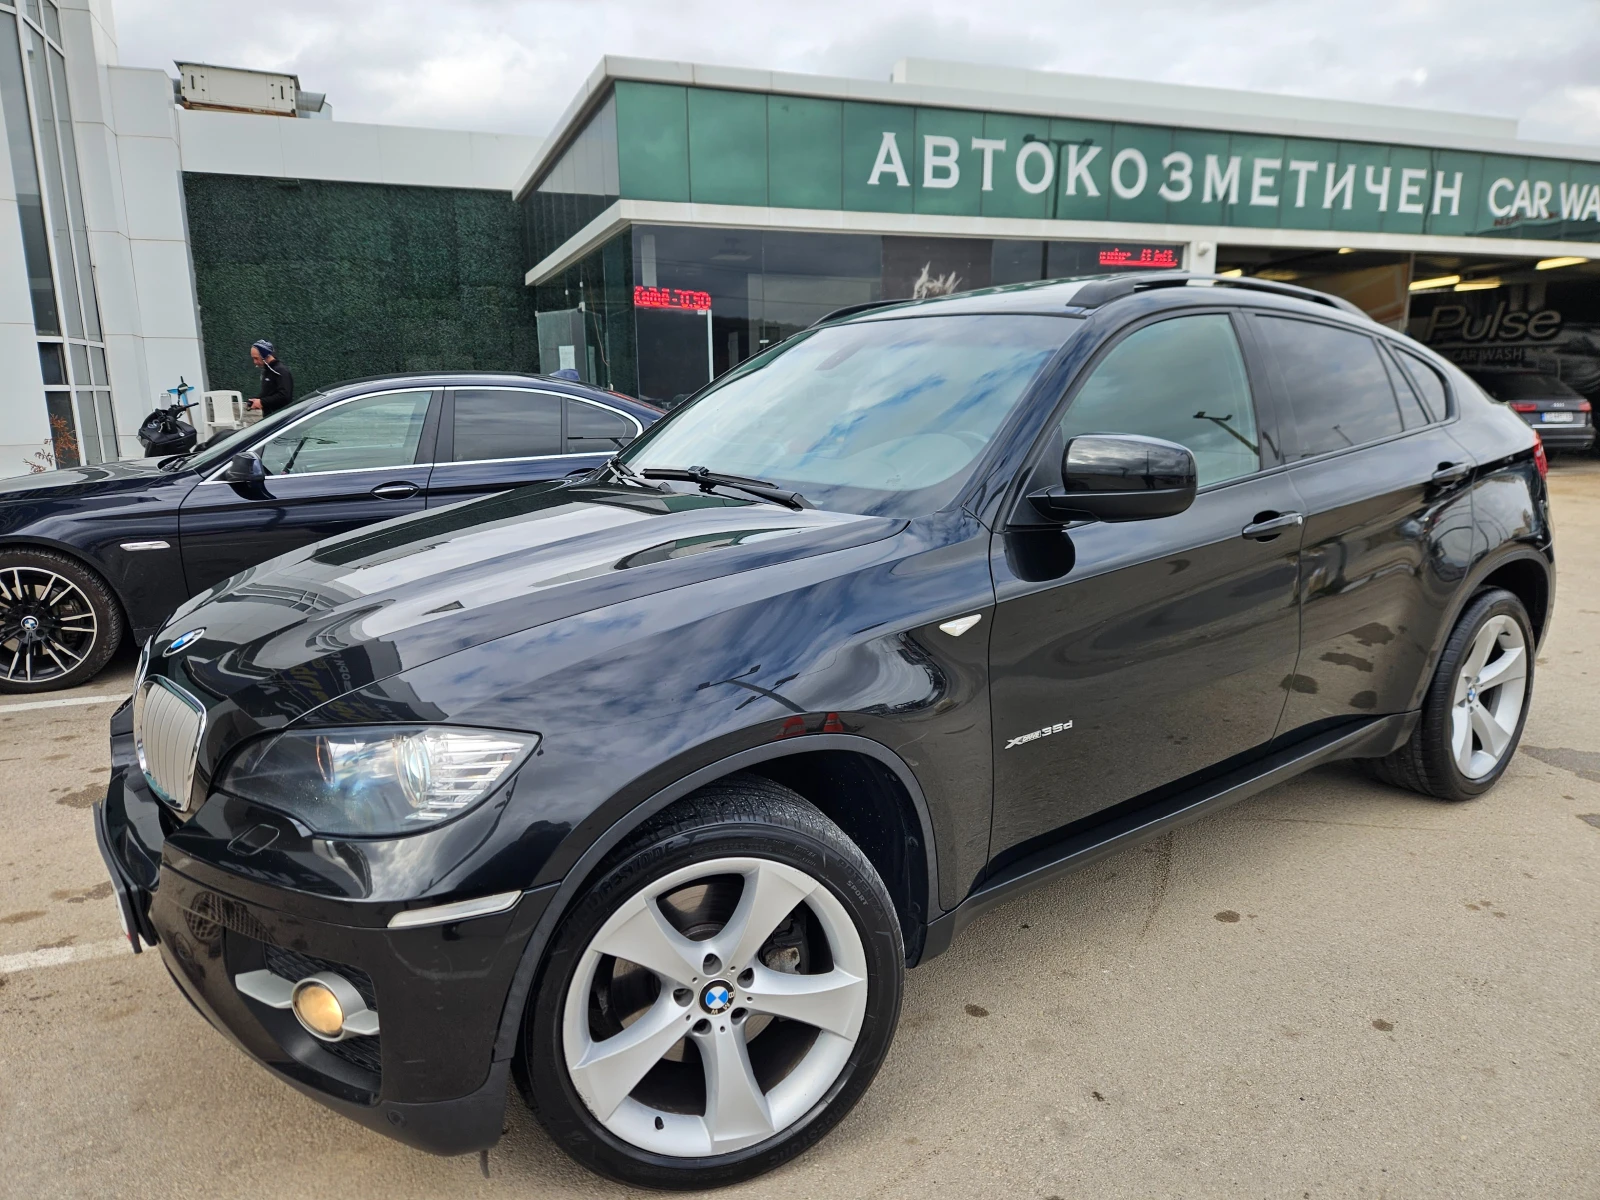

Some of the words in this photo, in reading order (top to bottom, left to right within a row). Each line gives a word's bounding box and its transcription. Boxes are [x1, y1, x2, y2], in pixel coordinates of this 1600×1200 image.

[867, 132, 1463, 216] АВТОКОЗМЕТИЧЕН
[1487, 177, 1553, 219] CAR
[1426, 301, 1562, 342] Pulse
[1453, 348, 1477, 361] CAR
[1481, 348, 1523, 361] WASH
[846, 879, 869, 906] SPORT
